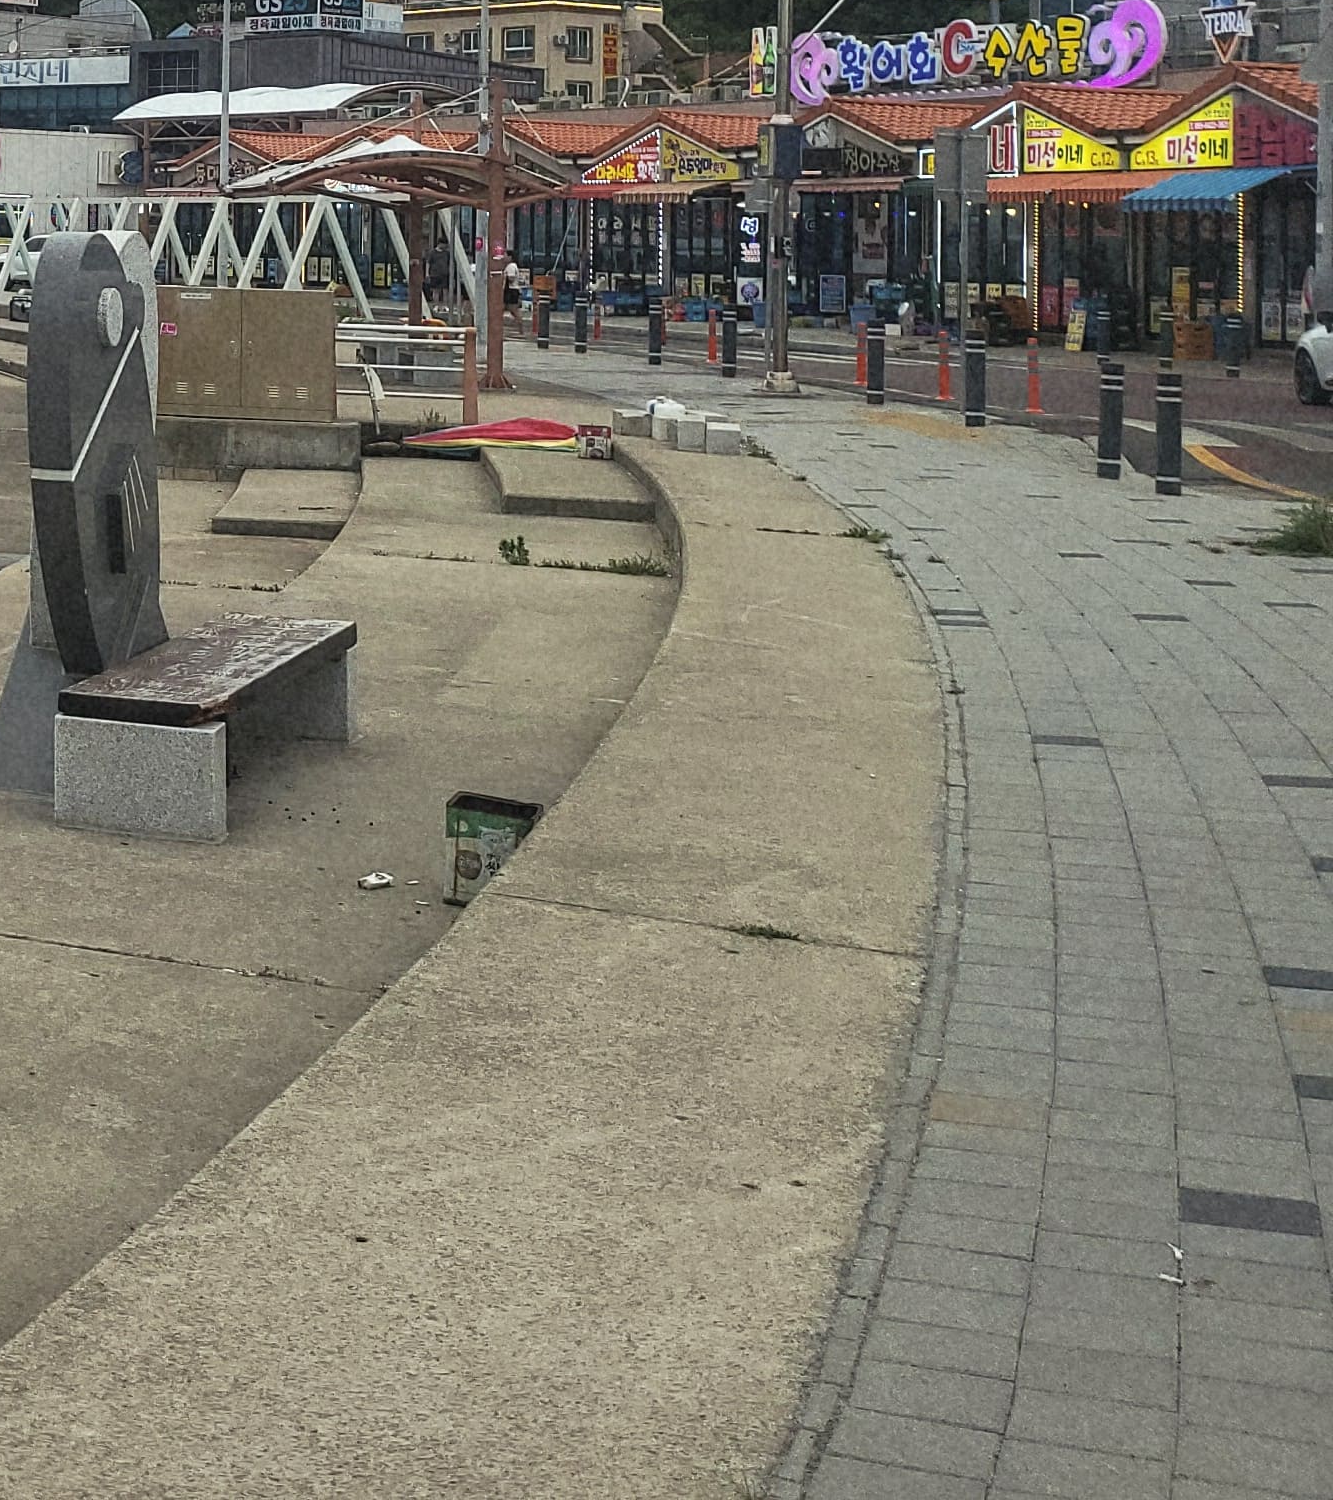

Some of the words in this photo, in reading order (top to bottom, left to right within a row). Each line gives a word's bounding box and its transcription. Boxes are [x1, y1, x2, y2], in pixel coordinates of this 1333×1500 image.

[1205, 10, 1245, 34] TERRA
[840, 34, 936, 91] 활어회
[943, 21, 975, 74] C
[985, 16, 1085, 77] 수산물
[0, 60, 69, 84] 민지네
[1027, 140, 1083, 168] 미선이네
[1167, 135, 1228, 165] 미선이네
